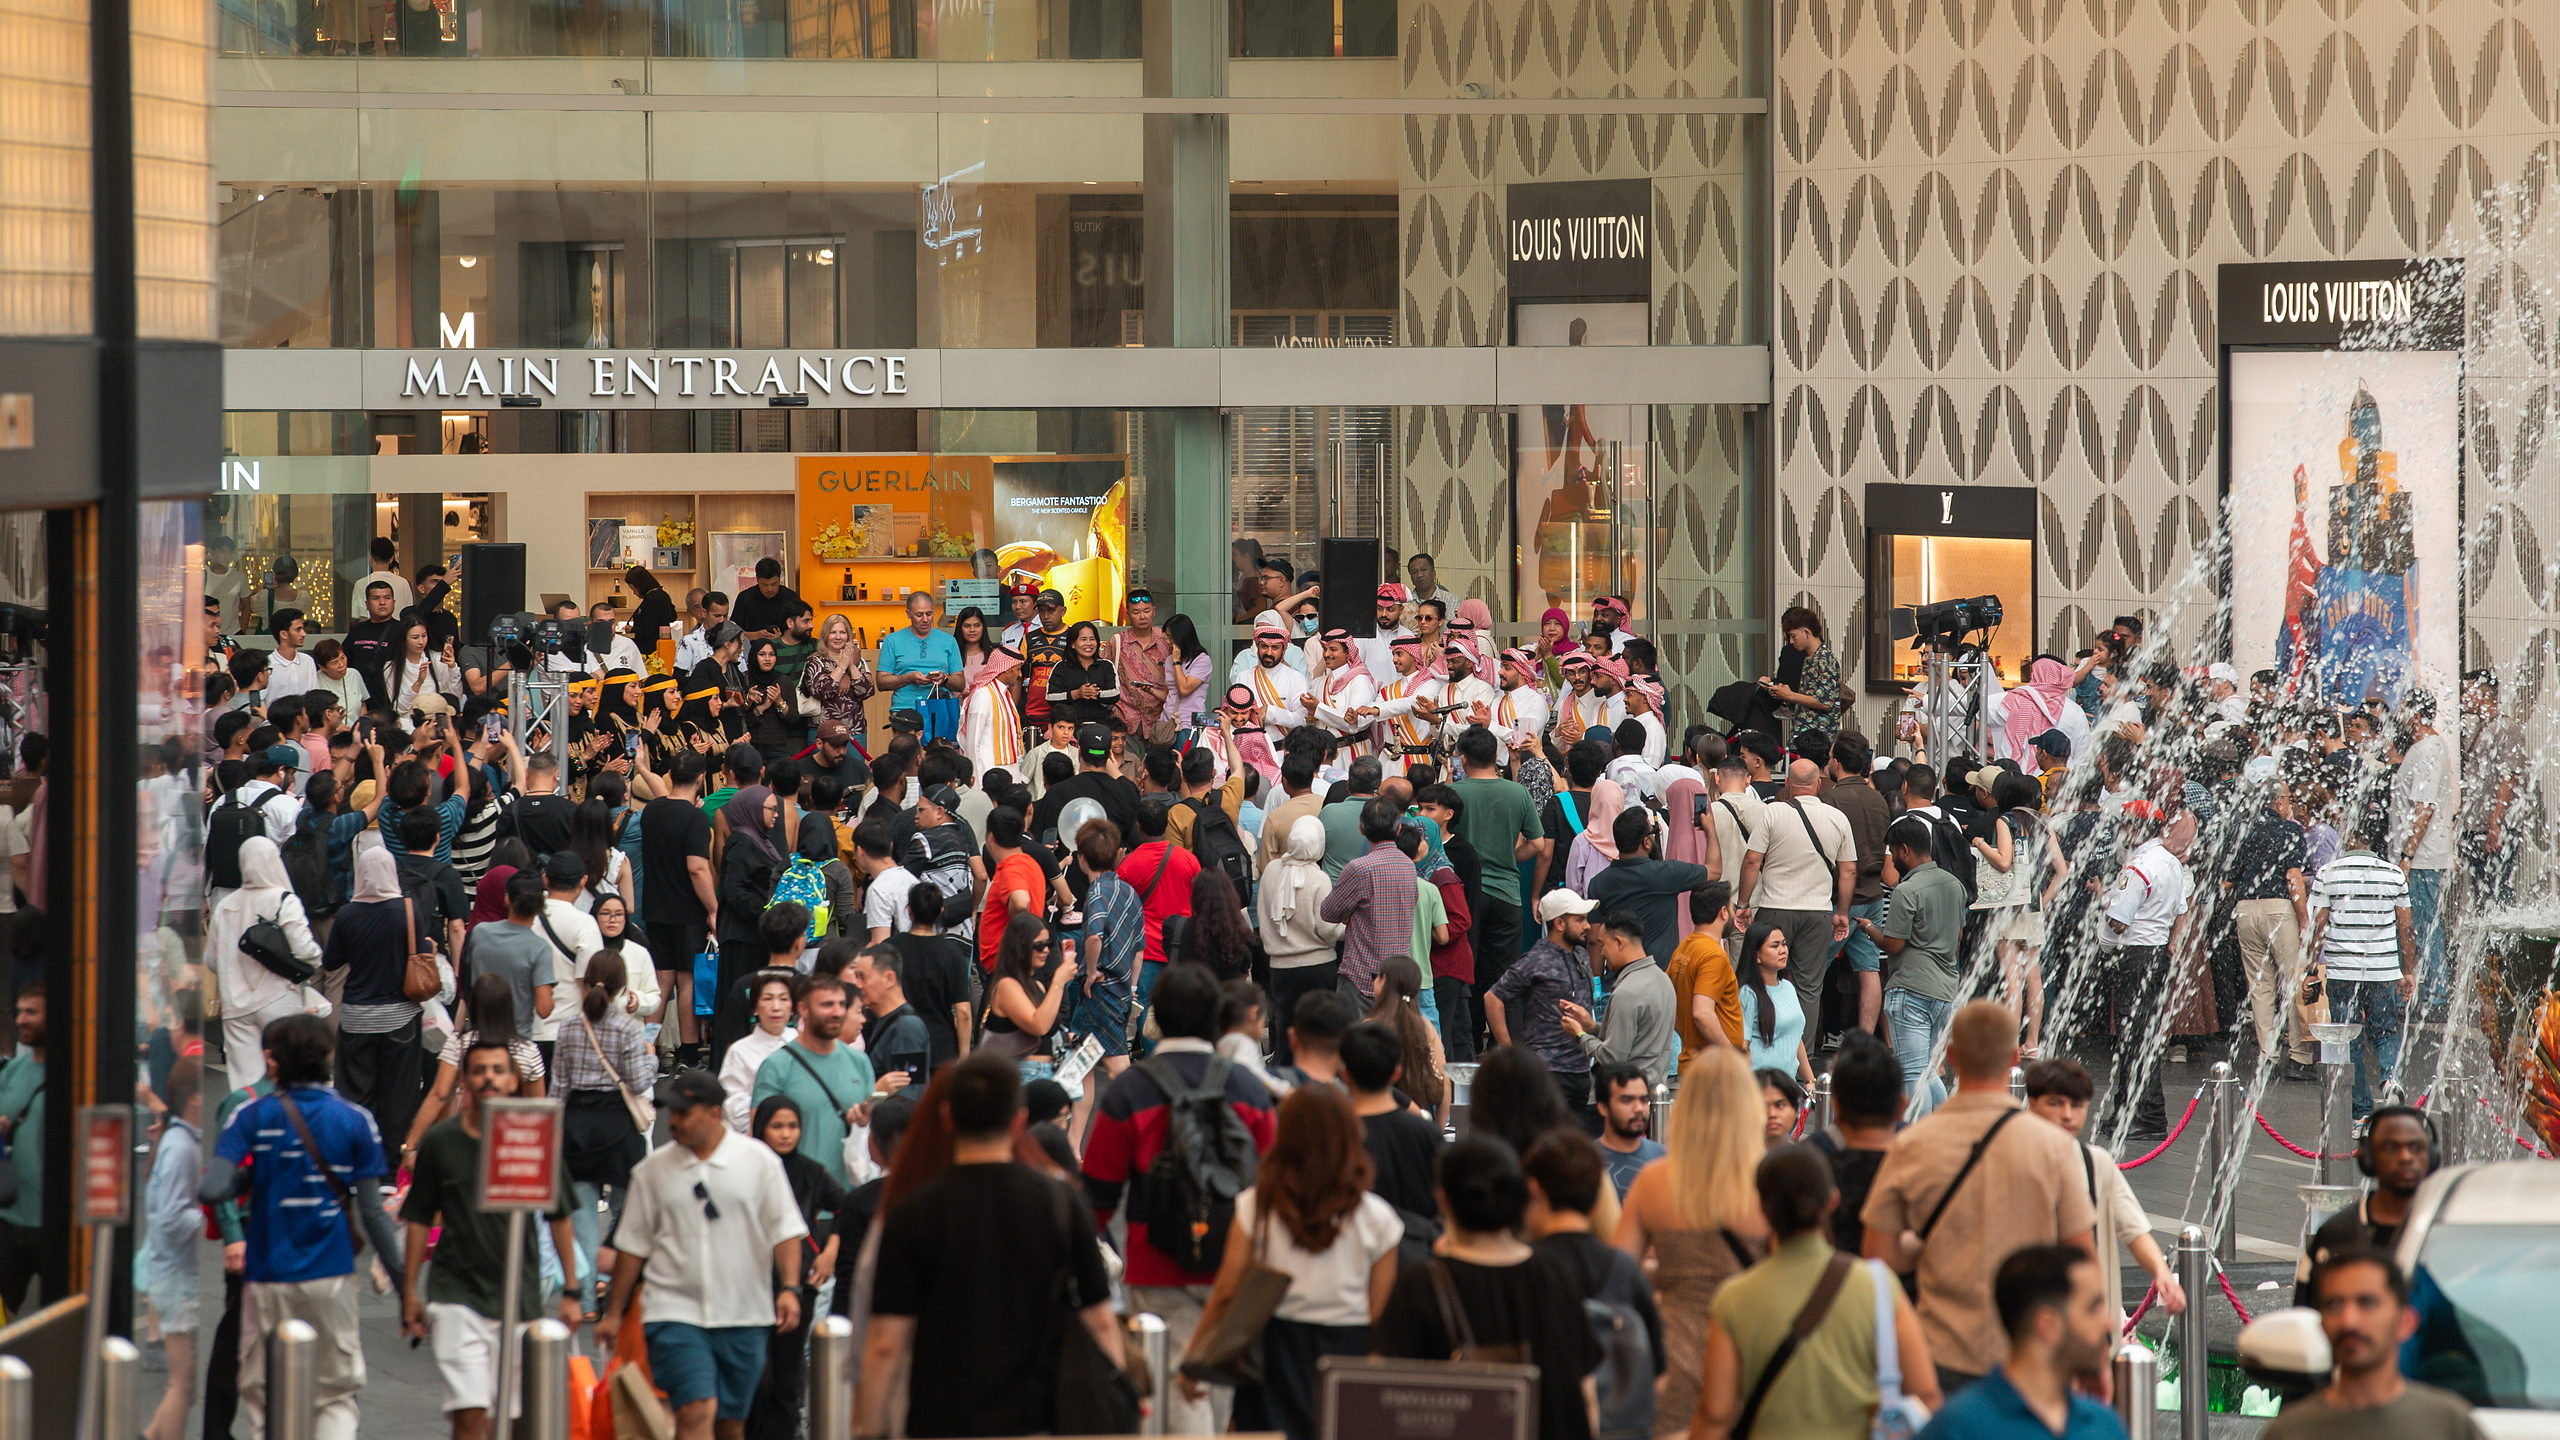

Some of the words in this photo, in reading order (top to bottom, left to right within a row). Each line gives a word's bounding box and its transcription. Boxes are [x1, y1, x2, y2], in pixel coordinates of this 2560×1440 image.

[1512, 217, 1562, 262] LOUIS
[1567, 213, 1644, 262] VUITTON
[2263, 281, 2320, 323] LOUIS
[2325, 279, 2411, 324] VUITTON
[440, 311, 474, 349] M
[400, 356, 560, 396] MAIN
[589, 356, 908, 396] ENTRANCE
[817, 470, 971, 492] GUERLAIN
[1010, 496, 1060, 506] BERGAMOTE
[1060, 496, 1108, 506] FANTASTICO
